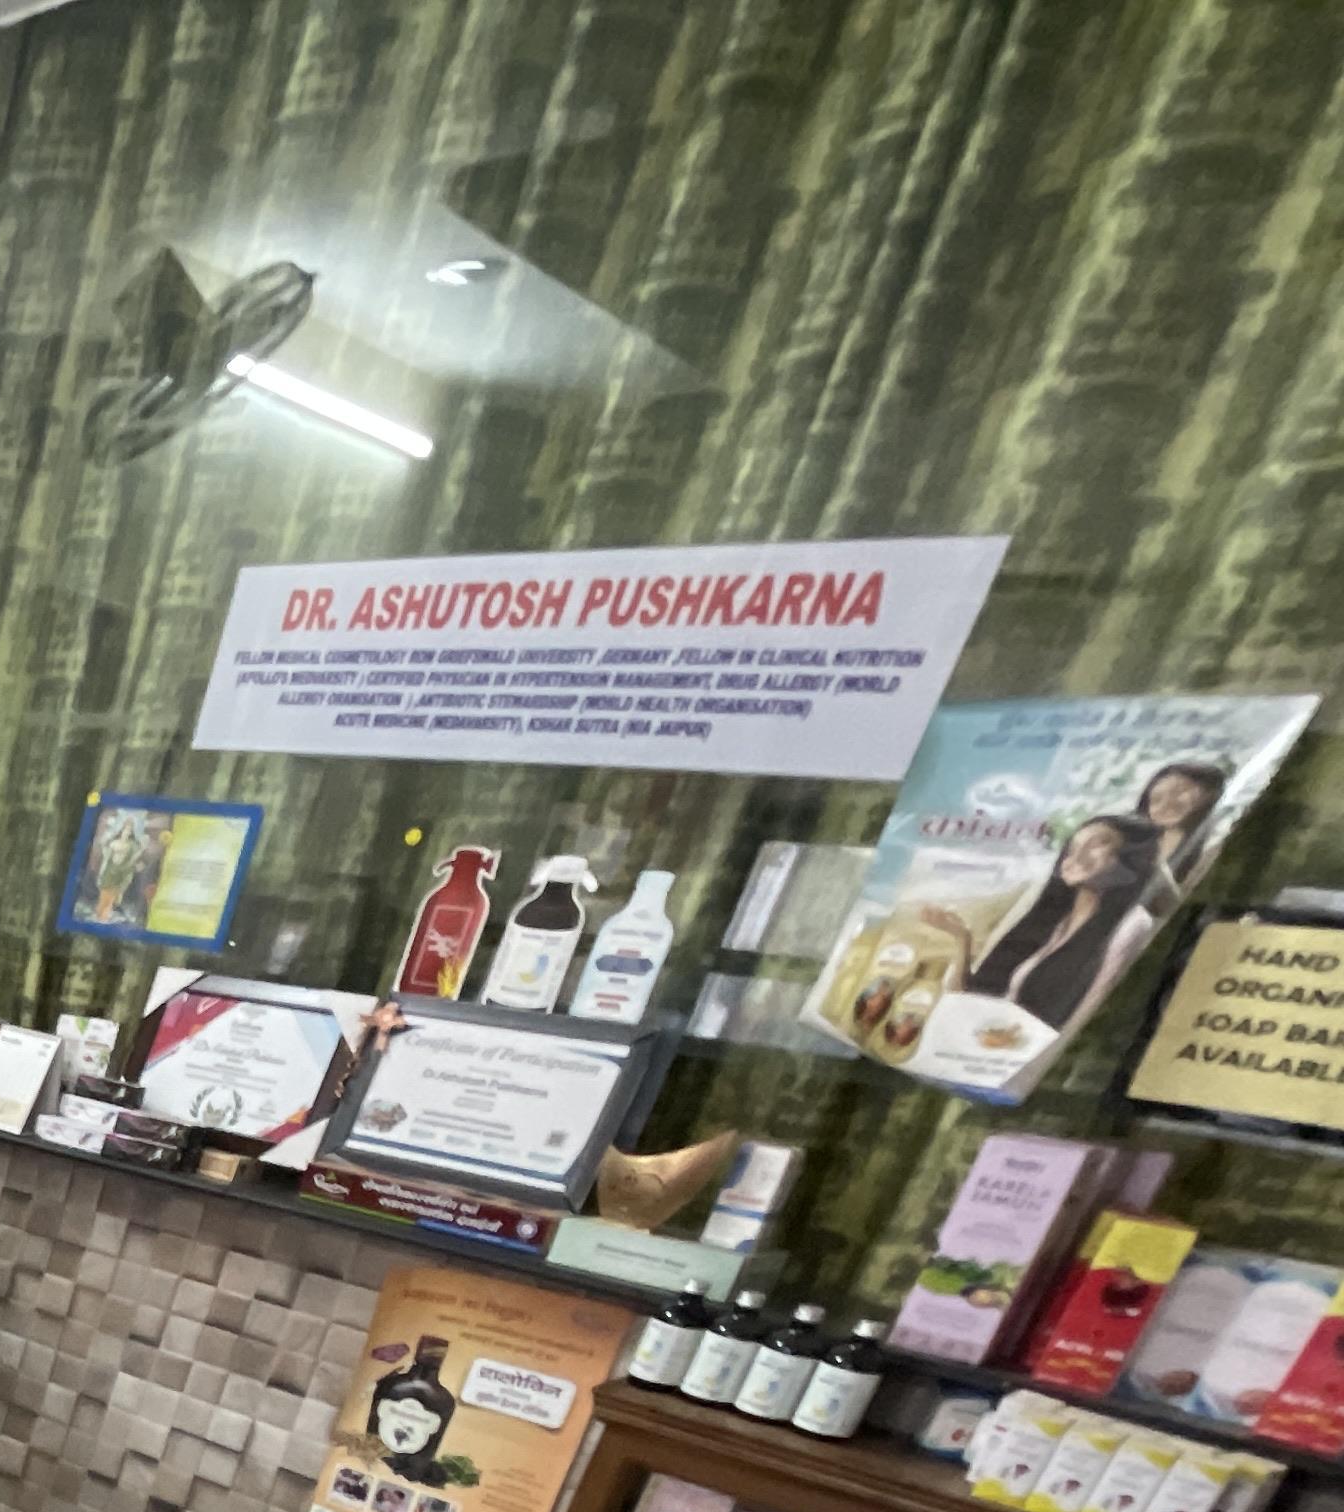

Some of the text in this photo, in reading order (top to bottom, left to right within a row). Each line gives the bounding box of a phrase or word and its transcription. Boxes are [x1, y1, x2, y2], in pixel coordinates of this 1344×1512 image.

[281, 571, 884, 632] DR. ASHUTOSH PUSHKARNA
[832, 648, 928, 667] NUTRITION
[761, 674, 834, 692] ALLERGY
[634, 696, 694, 712] HEALTH
[1238, 945, 1341, 972] HAND
[1193, 1012, 1278, 1036] SOAP
